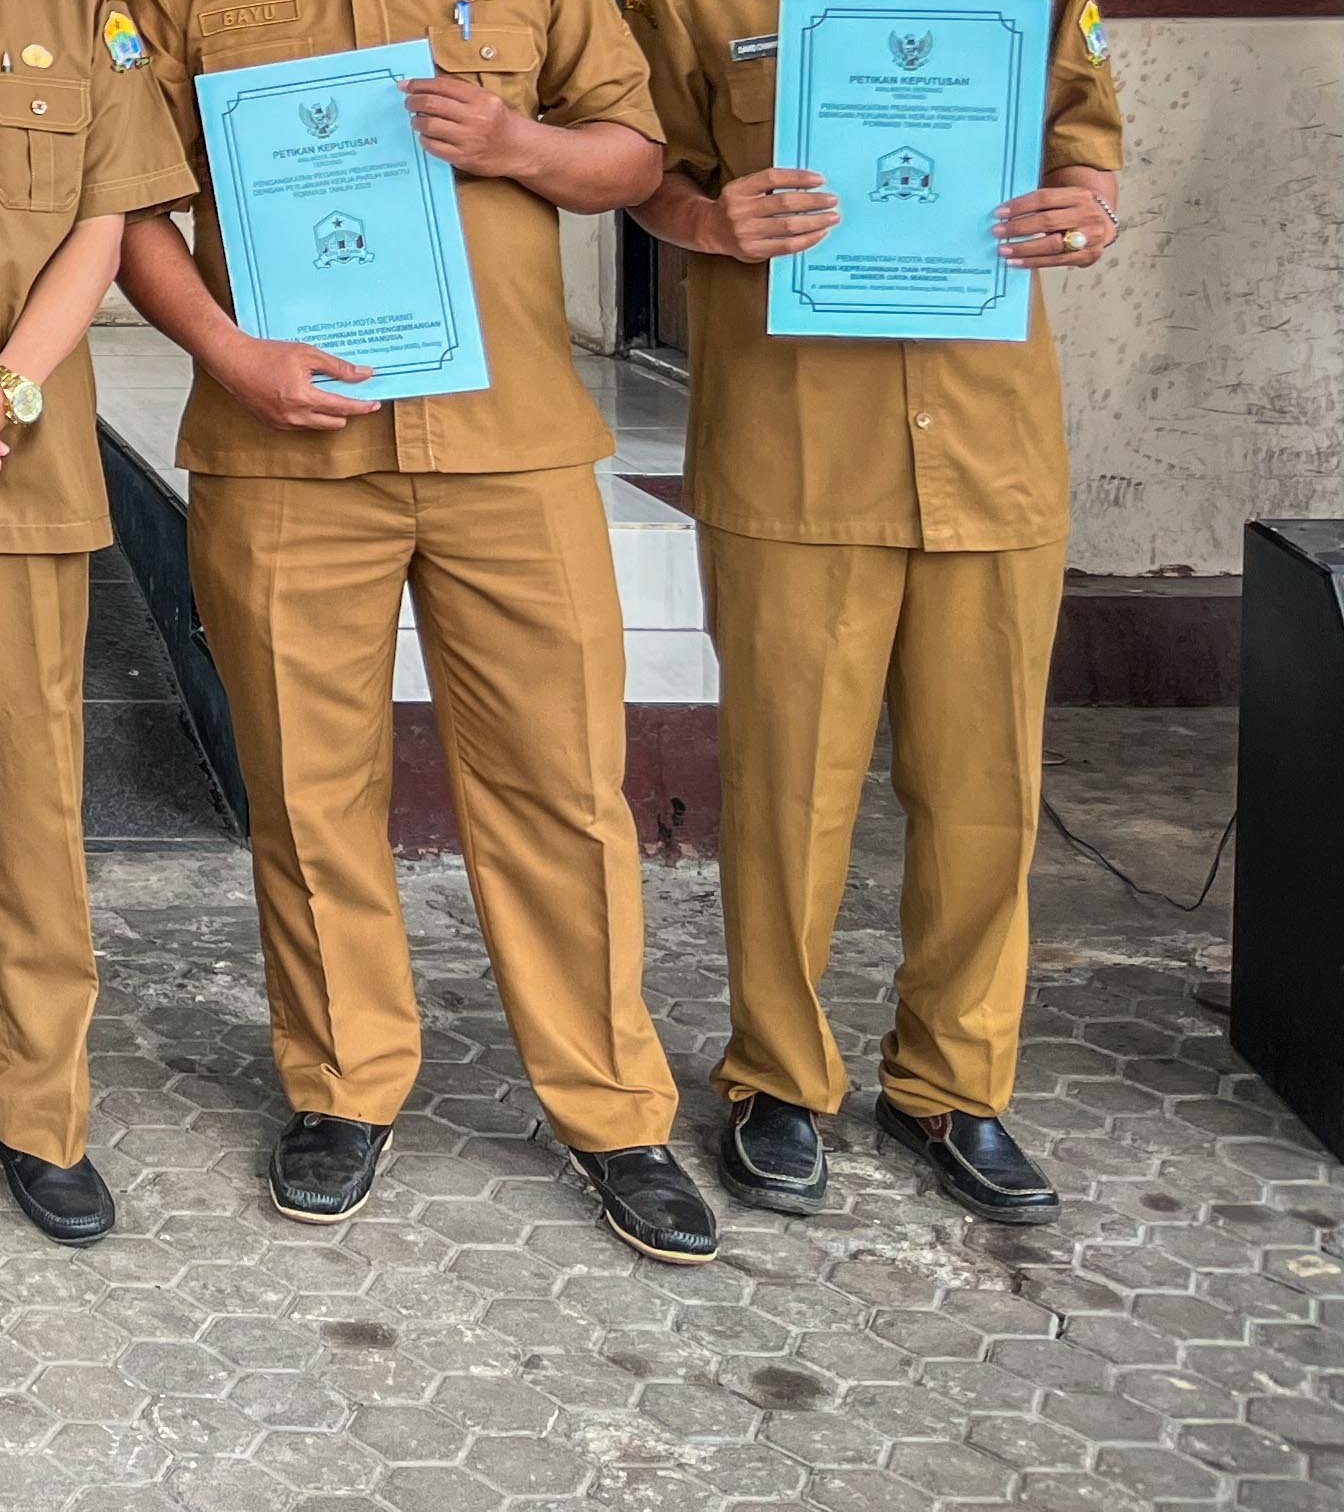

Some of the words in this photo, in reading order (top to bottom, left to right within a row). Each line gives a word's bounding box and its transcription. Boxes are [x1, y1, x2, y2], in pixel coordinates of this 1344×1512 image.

[224, 5, 275, 26] BAYU
[849, 76, 897, 85] PETIKAN
[900, 76, 969, 86] KEPUTUSAN
[273, 146, 315, 159] PETIKAN
[317, 137, 377, 153] KEPUTUSAN
[297, 321, 352, 334] PEMERINTAH
[352, 317, 376, 327] KOTA
